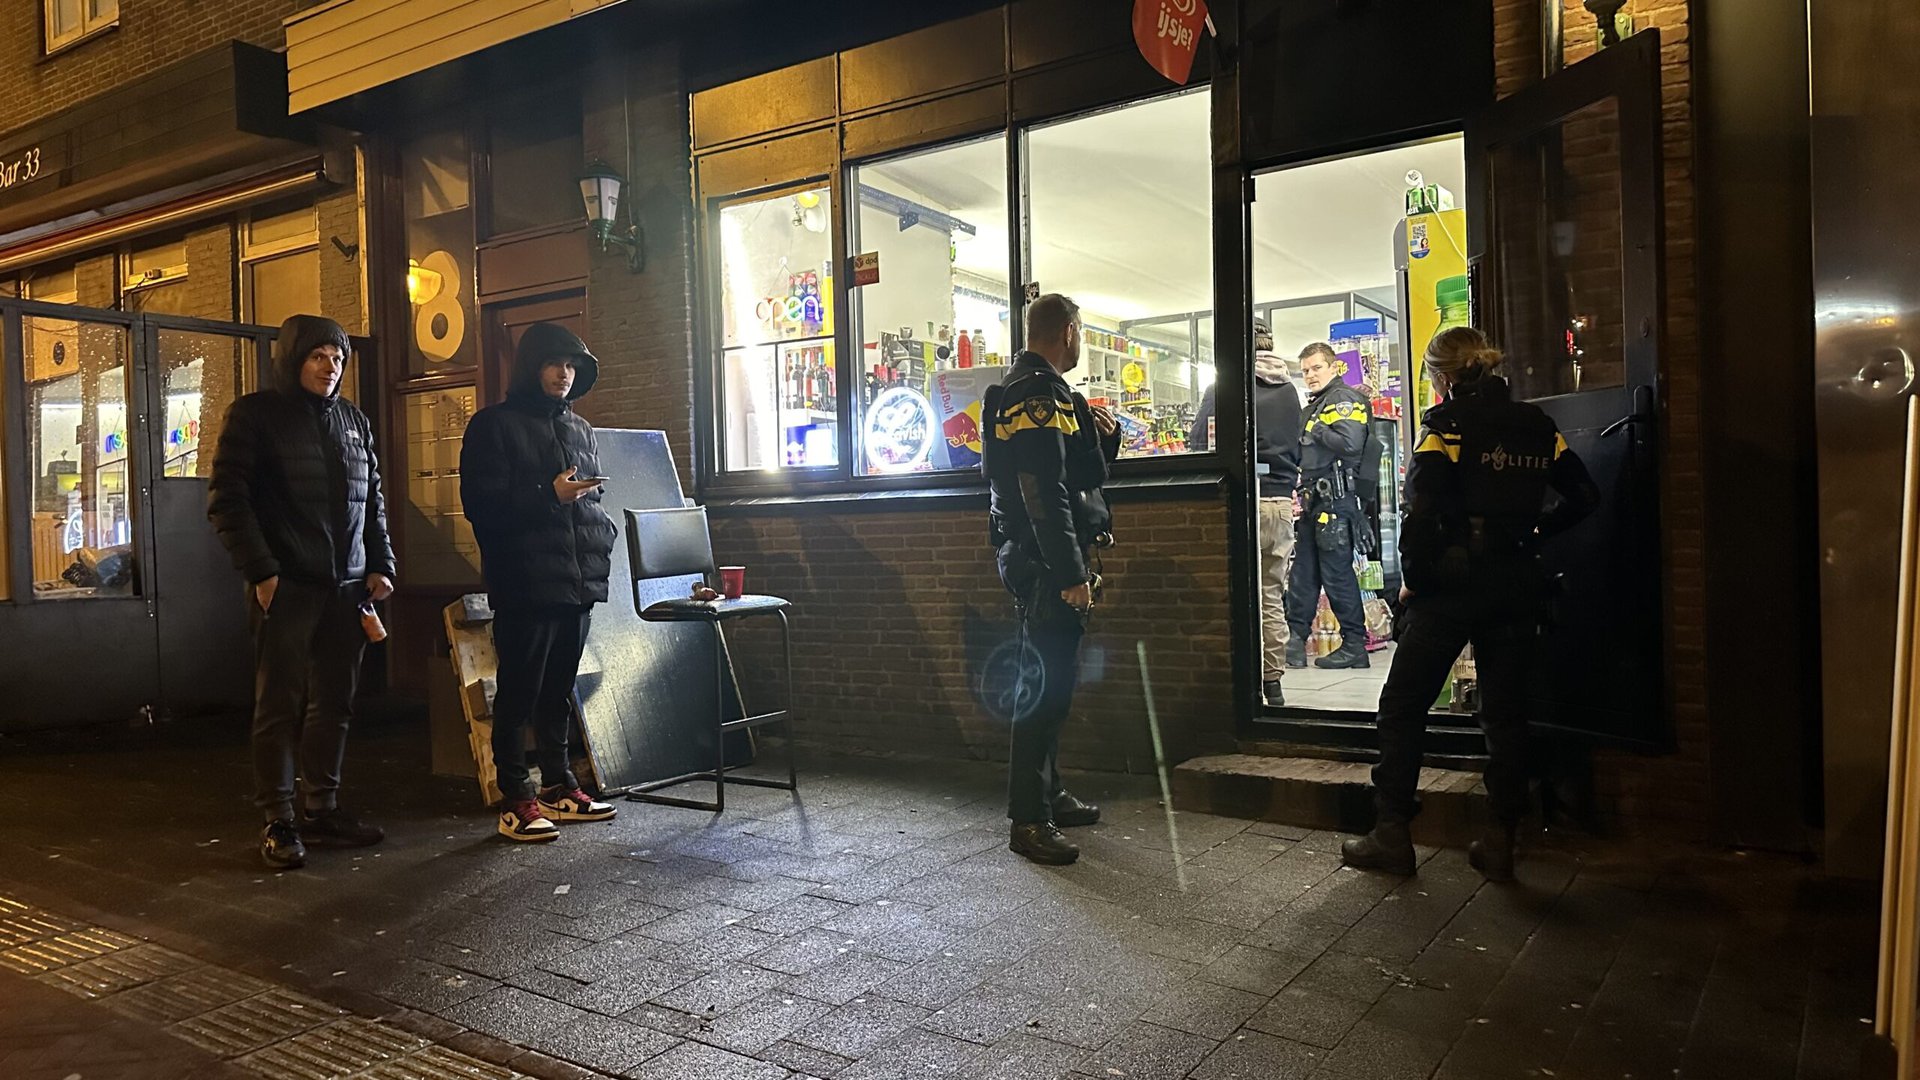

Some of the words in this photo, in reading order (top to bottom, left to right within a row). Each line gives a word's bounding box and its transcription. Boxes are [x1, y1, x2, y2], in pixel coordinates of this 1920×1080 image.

[1157, 2, 1193, 51] ijsje?
[22, 147, 40, 180] 33
[415, 250, 465, 363] 8
[755, 295, 820, 331] open
[938, 373, 949, 397] Red
[942, 393, 955, 415] Bull
